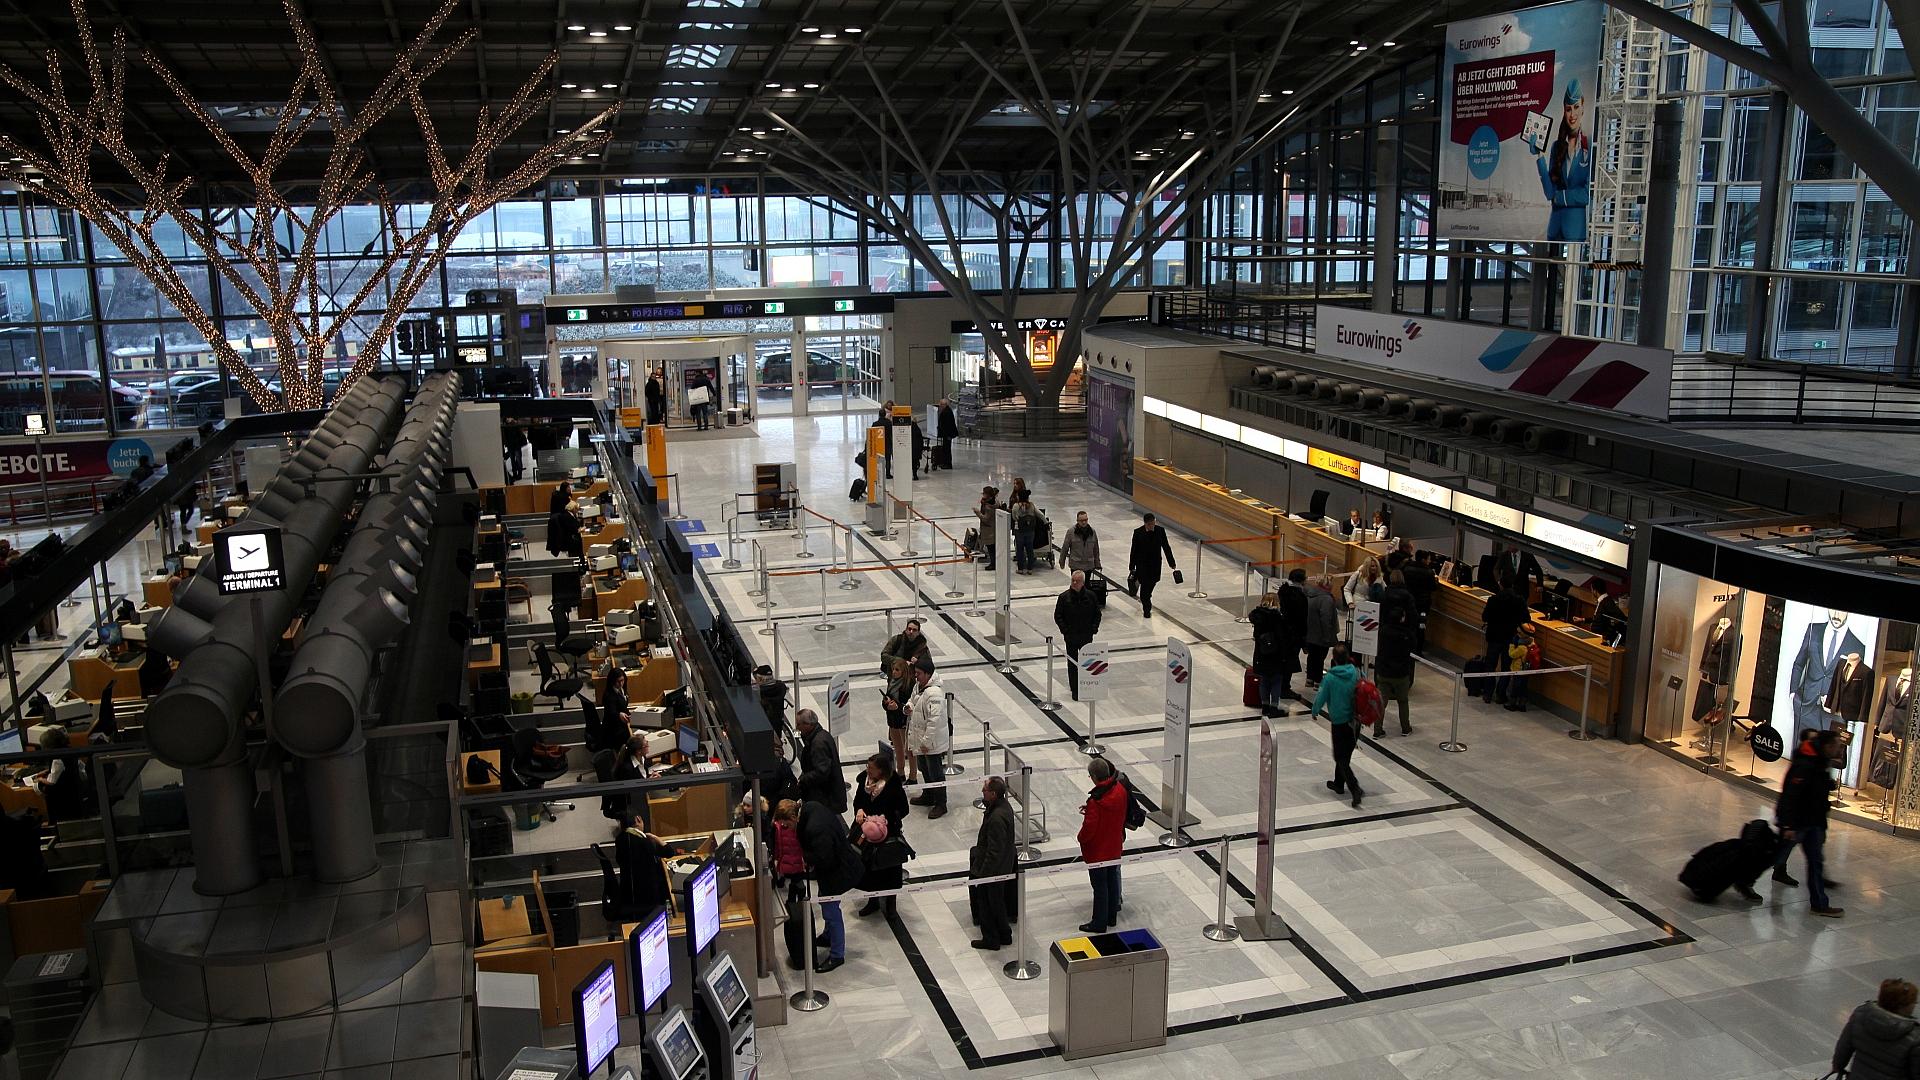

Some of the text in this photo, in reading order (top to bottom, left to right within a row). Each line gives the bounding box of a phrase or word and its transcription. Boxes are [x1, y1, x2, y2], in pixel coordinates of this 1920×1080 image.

[1459, 35, 1501, 51] Eurowings
[1457, 61, 1546, 83] AB JETZT GEHT JEDER FLUG
[1457, 80, 1518, 96] ÜBER HOLLYWOOD.
[1336, 324, 1402, 358] Eurowings
[877, 429, 884, 439] 2
[119, 448, 140, 457] Jetzt
[1328, 456, 1359, 475] Lufthansa
[1463, 502, 1510, 525] Tickets & Service
[222, 572, 244, 581] ABFLUG
[247, 569, 279, 579] DEPARTURE
[223, 577, 280, 591] TERMINAL 1
[1755, 734, 1780, 751] SALE
